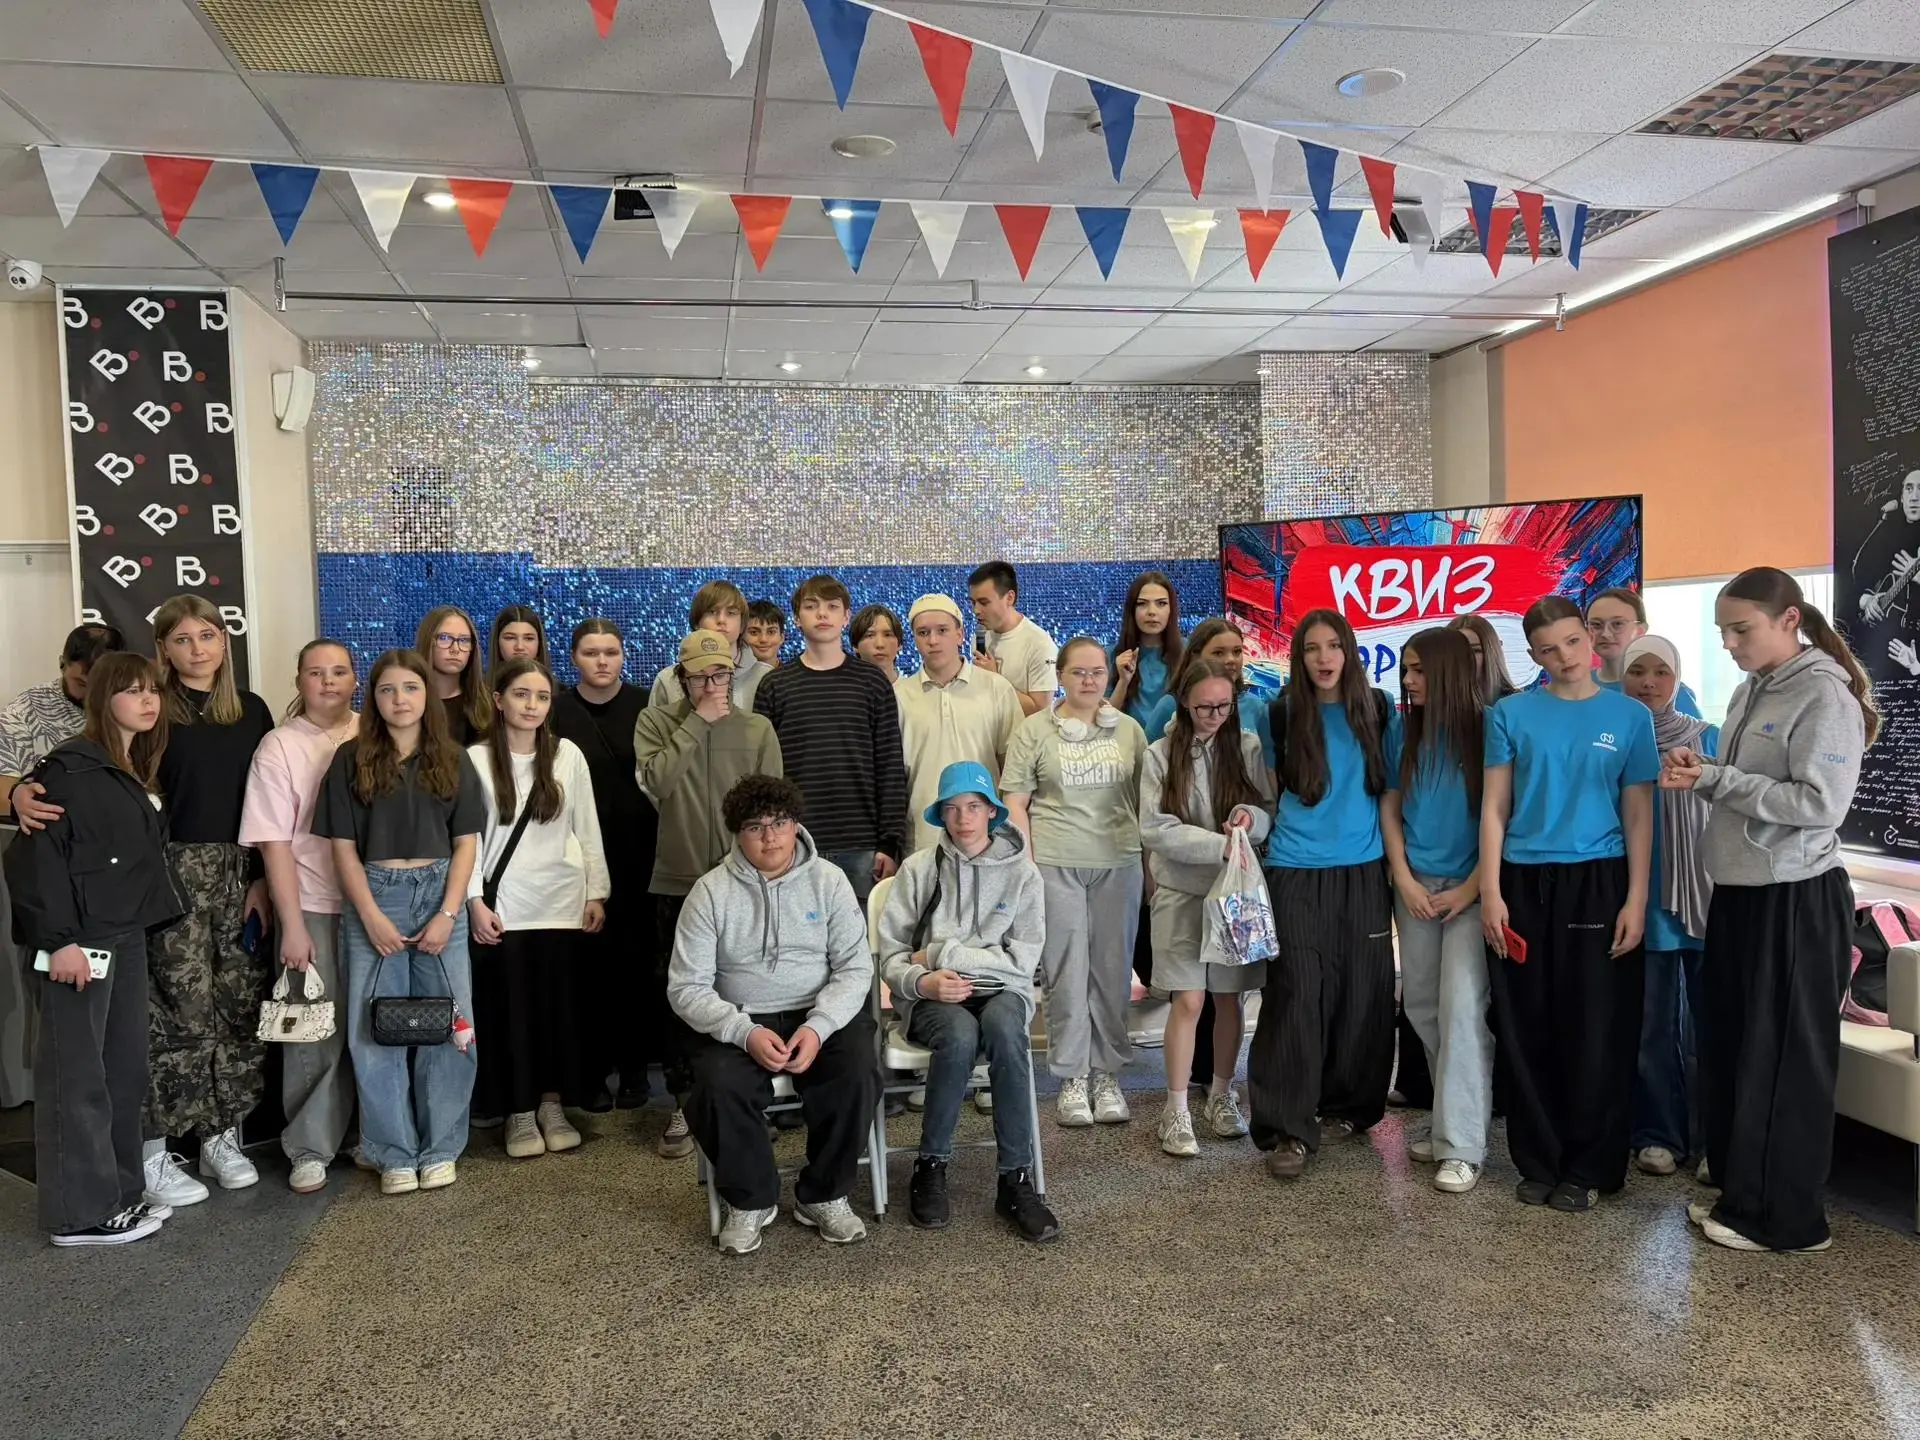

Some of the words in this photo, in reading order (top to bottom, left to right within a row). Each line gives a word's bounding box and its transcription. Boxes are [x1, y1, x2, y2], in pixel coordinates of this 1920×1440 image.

[1329, 555, 1495, 620] КВИЗ
[1059, 746, 1125, 775] BEAUTIFUL
[1061, 760, 1126, 786] MOMENTS
